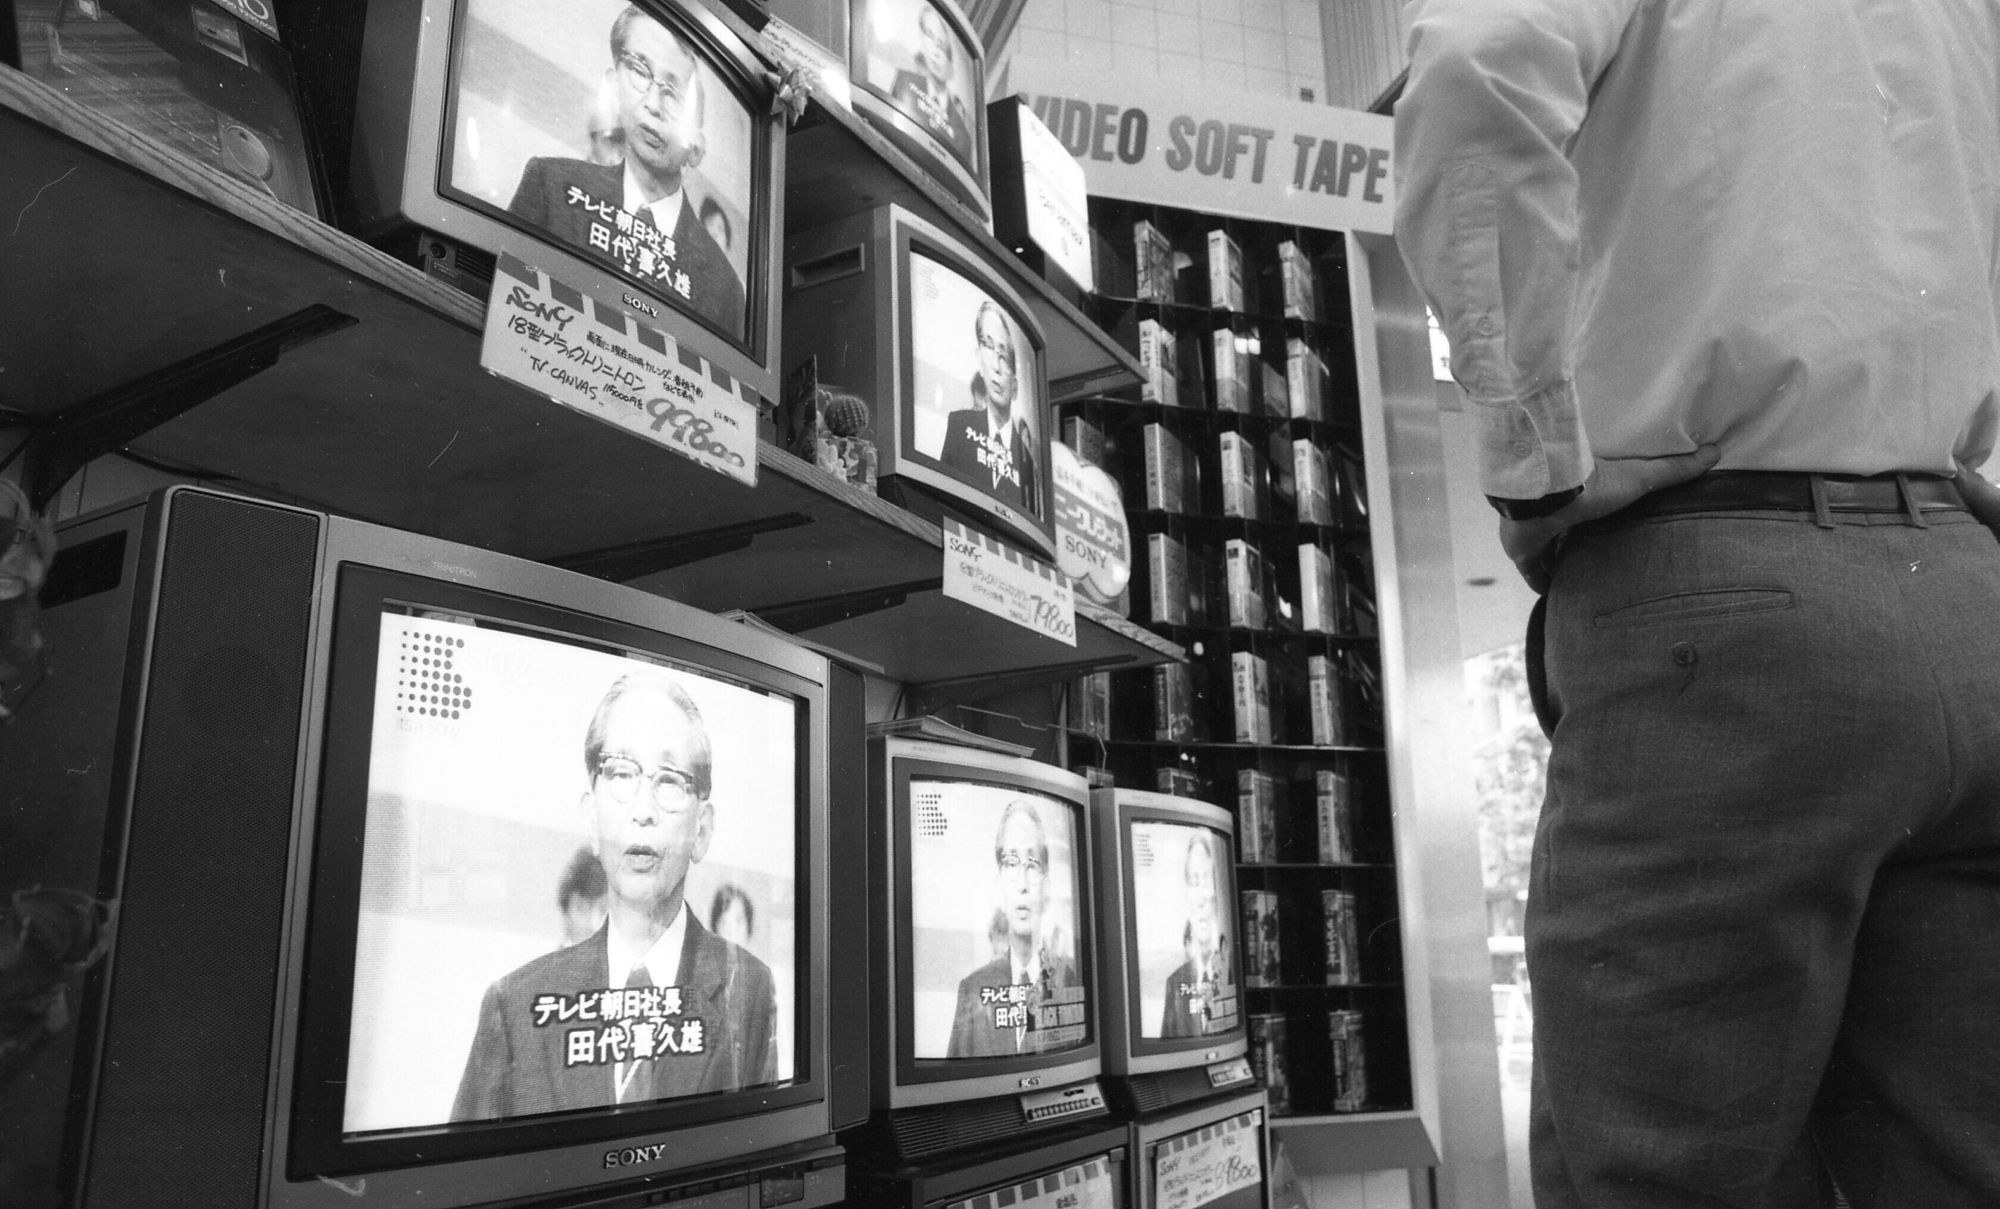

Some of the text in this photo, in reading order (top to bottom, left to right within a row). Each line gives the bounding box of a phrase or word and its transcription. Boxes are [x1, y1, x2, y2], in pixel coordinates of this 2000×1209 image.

[1164, 115, 1275, 184] SOFT
[1292, 133, 1390, 204] TAPE
[566, 185, 677, 261] テレビ朝日社長
[588, 221, 692, 300] 田代喜久雄
[505, 285, 575, 332] SONY
[622, 292, 659, 318] SONY
[1064, 535, 1109, 569] SONY
[533, 987, 683, 1025] テレビ朝日社長
[566, 1020, 704, 1066] 田代喜久雄
[603, 1143, 666, 1169] SONY
